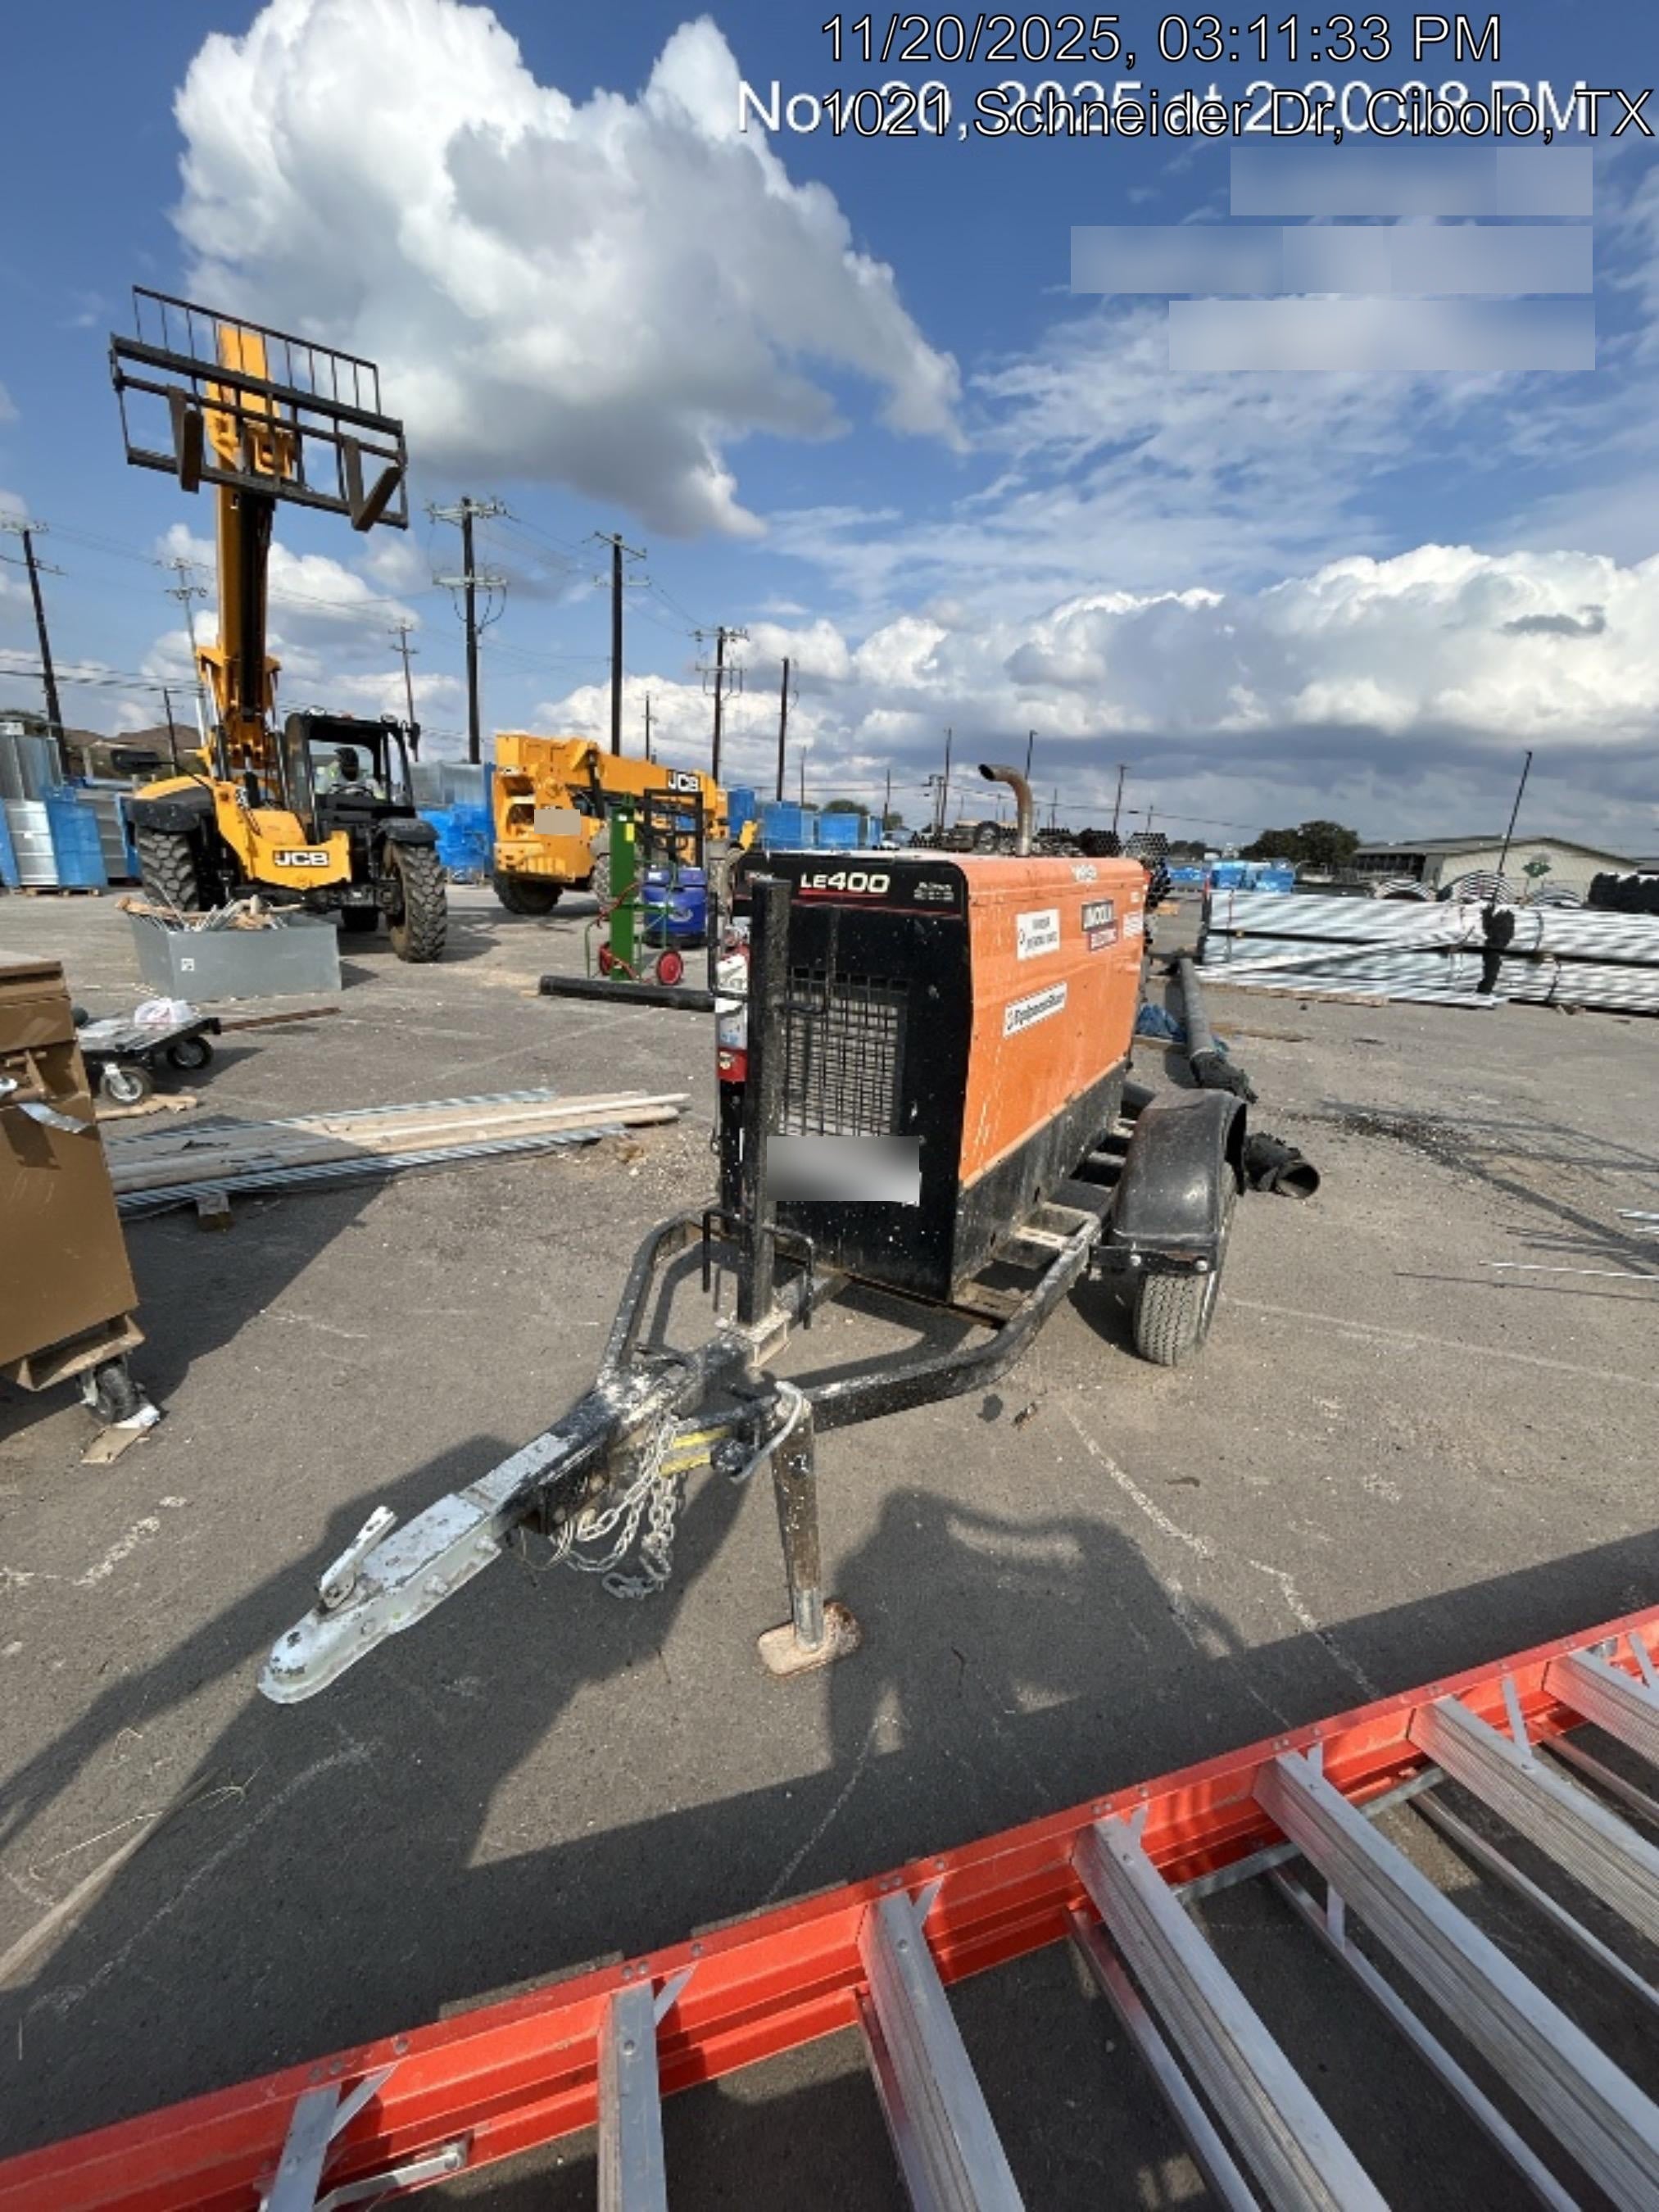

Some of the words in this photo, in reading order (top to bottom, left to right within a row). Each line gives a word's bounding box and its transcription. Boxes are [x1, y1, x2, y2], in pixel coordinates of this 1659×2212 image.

[667, 768, 700, 792] JCB
[274, 851, 329, 867] JCB
[800, 872, 891, 894] LE400
